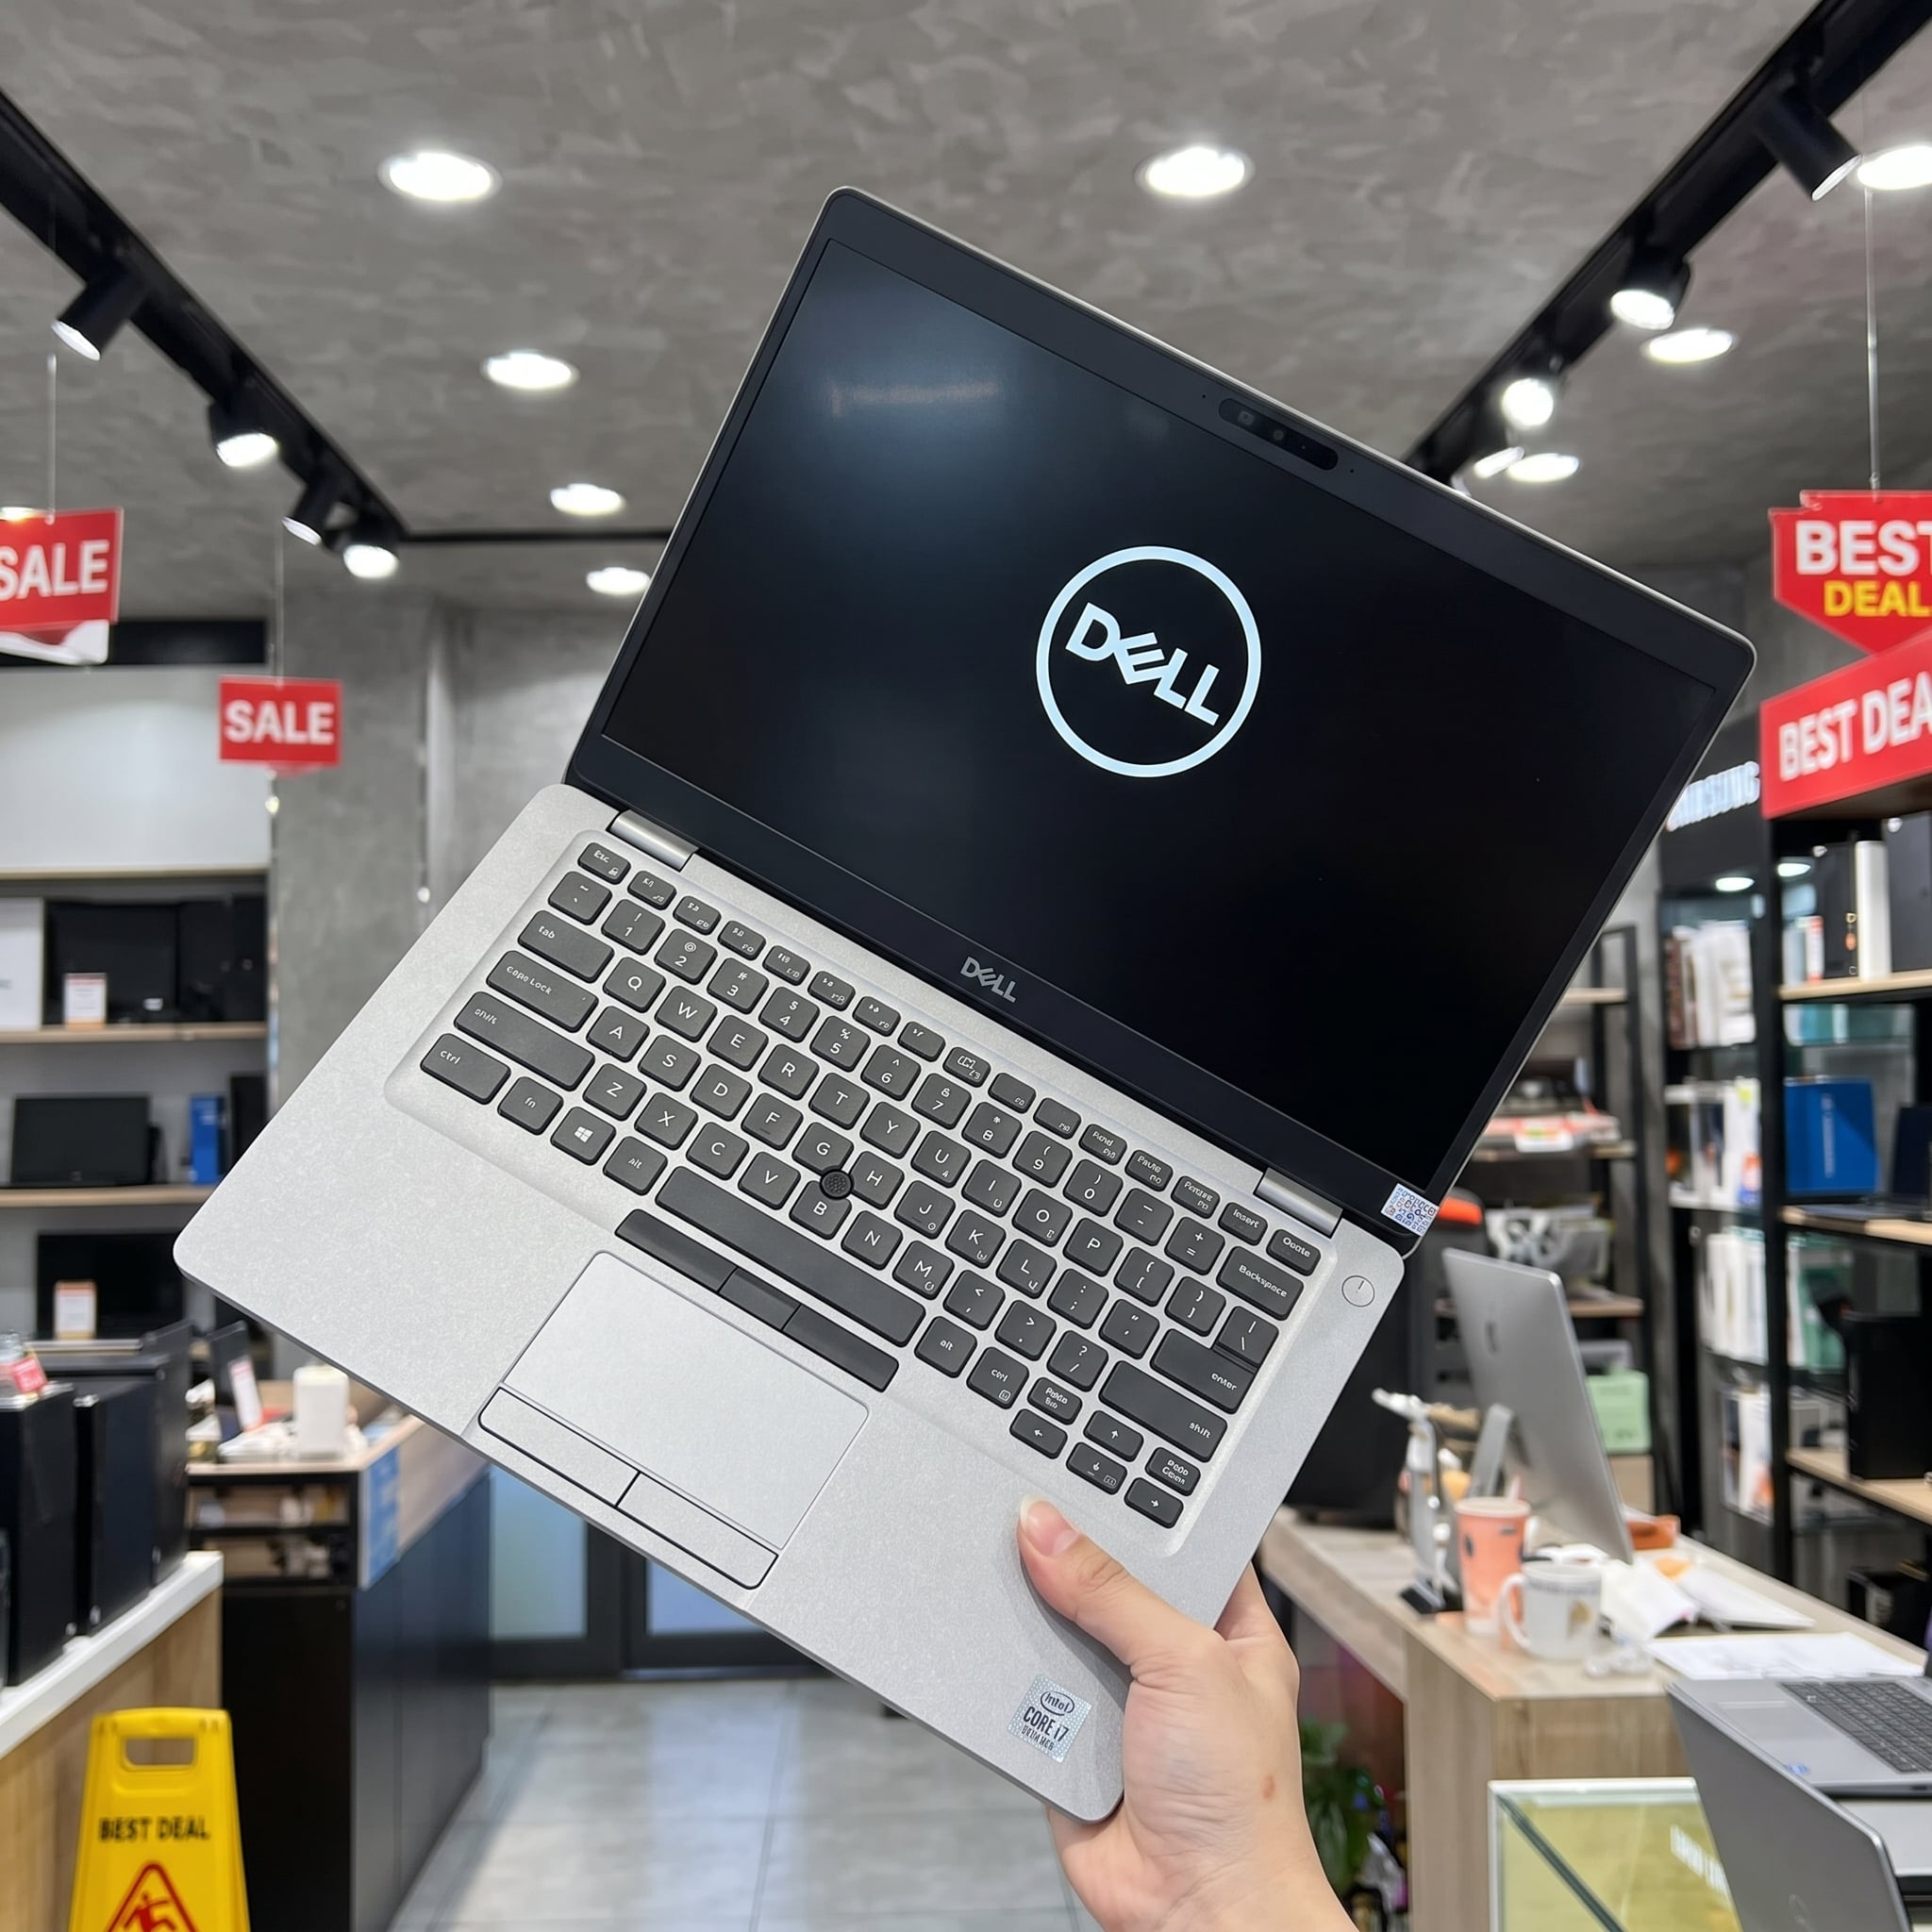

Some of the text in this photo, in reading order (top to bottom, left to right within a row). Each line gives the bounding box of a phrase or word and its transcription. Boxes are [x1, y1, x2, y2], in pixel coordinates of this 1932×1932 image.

[0, 540, 110, 601] SALE
[1824, 580, 1932, 617] DEAL
[1065, 602, 1220, 726] DELL
[225, 700, 335, 744] SALE
[1779, 698, 1857, 781] BEST
[538, 925, 556, 940] tab
[625, 926, 633, 937] 1
[674, 955, 688, 967] 2
[627, 975, 642, 991] Q
[960, 956, 1017, 1004] DELL
[726, 984, 740, 997] 3
[678, 1001, 698, 1020] W
[778, 1015, 791, 1026] 4
[608, 1025, 624, 1040] A
[729, 1033, 746, 1049] E
[829, 1041, 842, 1055] 5
[661, 1054, 677, 1068] S
[780, 1061, 796, 1078] R
[881, 1072, 893, 1088] 6
[606, 1081, 624, 1098] Z
[712, 1081, 728, 1097] D
[835, 1091, 849, 1106] T
[931, 1099, 944, 1110] 7
[657, 1110, 675, 1127] X
[765, 1111, 781, 1124] F
[886, 1119, 899, 1134] Y
[982, 1129, 994, 1141] 8
[710, 1141, 725, 1156] C
[816, 1141, 831, 1156] G
[934, 1148, 950, 1164] U
[1032, 1158, 1044, 1171] 9
[764, 1170, 779, 1184] V
[866, 1170, 884, 1187] H
[812, 1200, 828, 1216] B
[919, 1204, 933, 1215] J
[1036, 1208, 1050, 1223] O
[864, 1229, 881, 1247] N
[968, 1228, 985, 1245] K
[1086, 1237, 1101, 1249] P
[913, 1259, 933, 1278] M
[1020, 1258, 1030, 1274] L
[1238, 1264, 1288, 1298] Backspace
[1023, 1707, 1056, 1737] CORE
[99, 1816, 210, 1841] BEST DEAL
